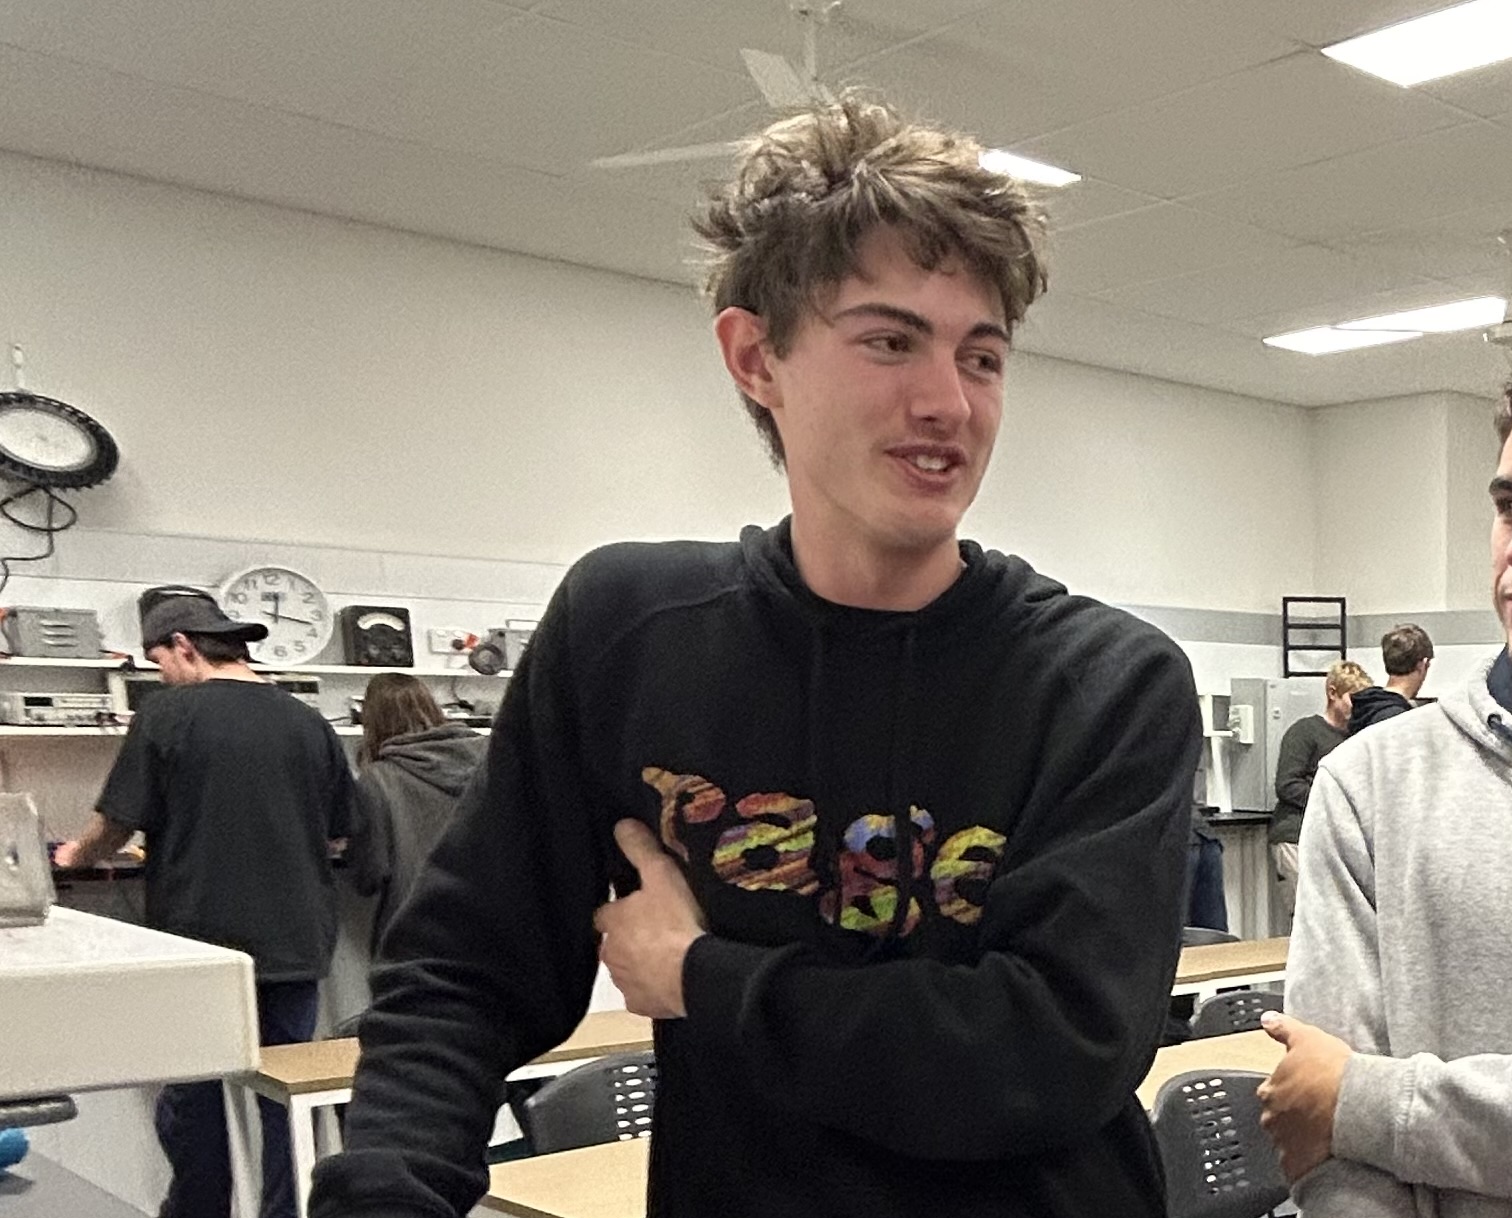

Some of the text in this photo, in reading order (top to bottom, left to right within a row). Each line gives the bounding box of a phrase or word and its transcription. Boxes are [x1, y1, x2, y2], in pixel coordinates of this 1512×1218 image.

[263, 574, 280, 585] 12
[302, 592, 316, 604] 2
[273, 645, 288, 657] 6
[293, 640, 306, 652] 5
